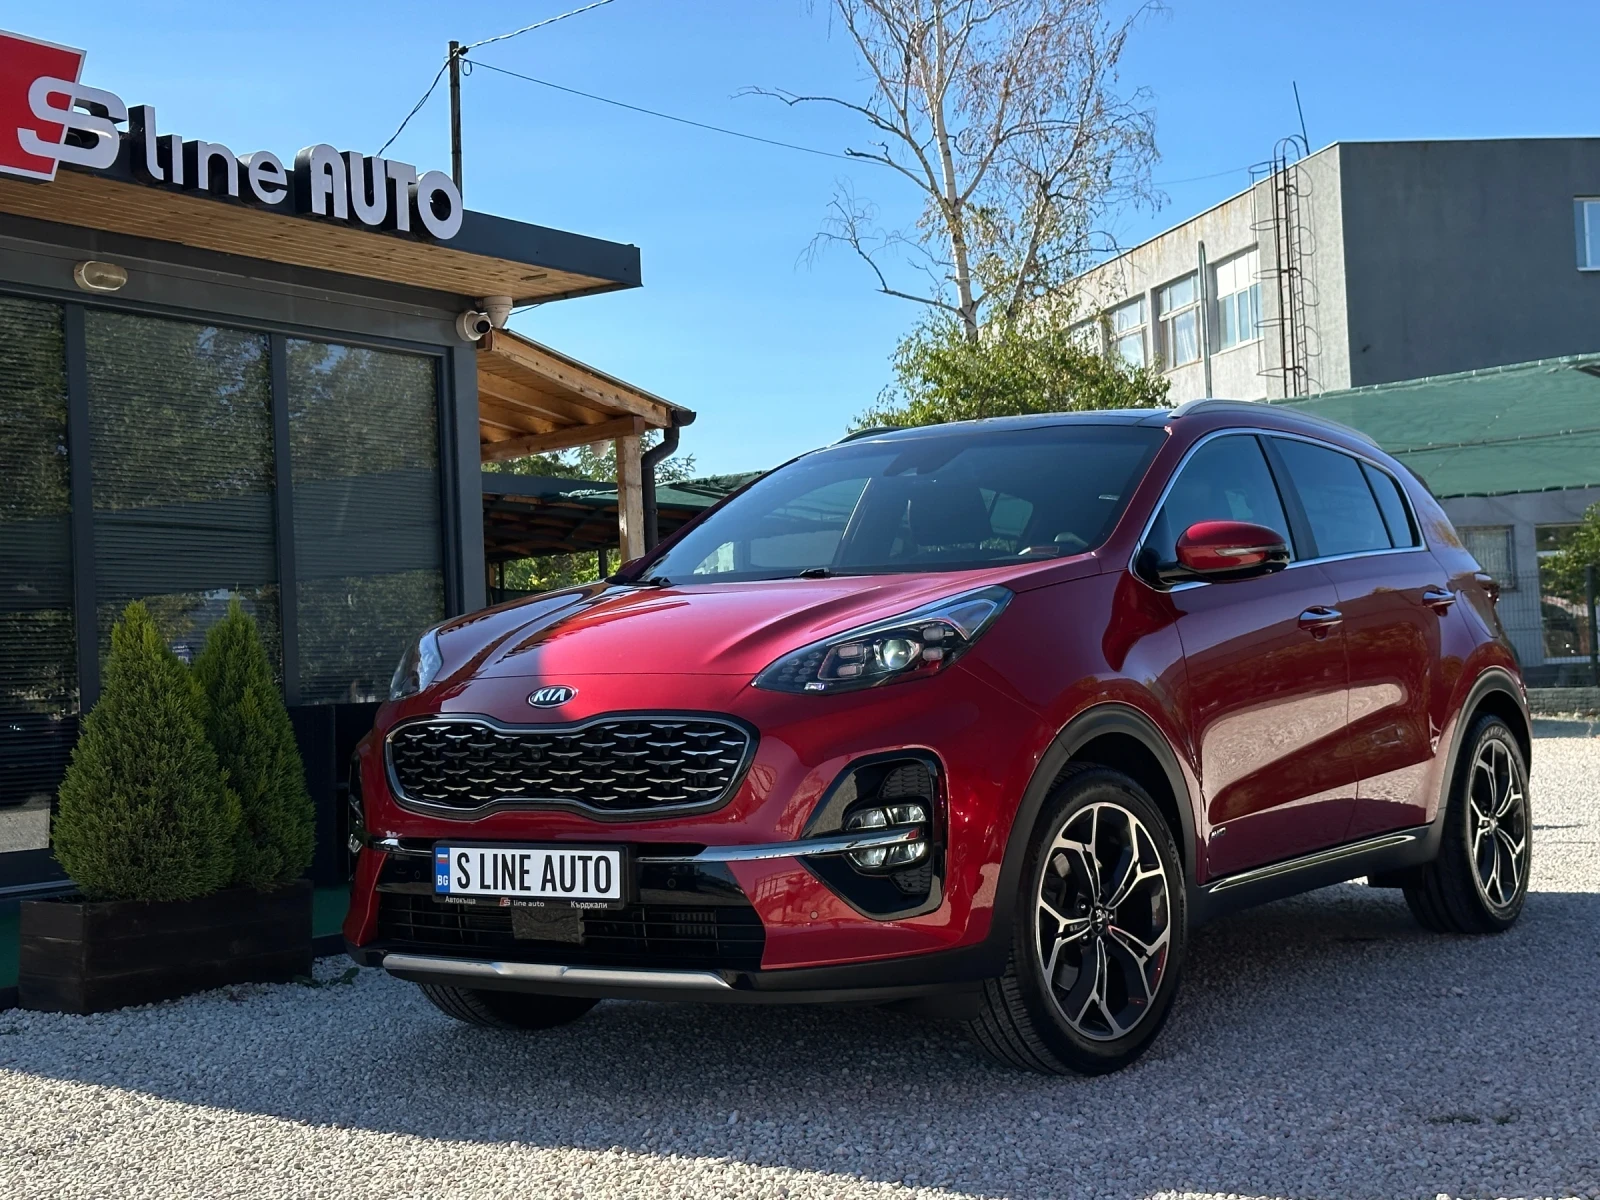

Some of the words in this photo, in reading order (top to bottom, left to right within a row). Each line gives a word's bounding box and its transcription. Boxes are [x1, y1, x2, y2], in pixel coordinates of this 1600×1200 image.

[17, 75, 127, 170] S
[298, 143, 464, 240] AUTO
[533, 688, 567, 702] KIA
[437, 874, 449, 886] BG
[456, 852, 471, 889] S
[479, 853, 532, 891] LINE
[540, 854, 612, 894] AUTO
[570, 900, 608, 910] Кърджали
